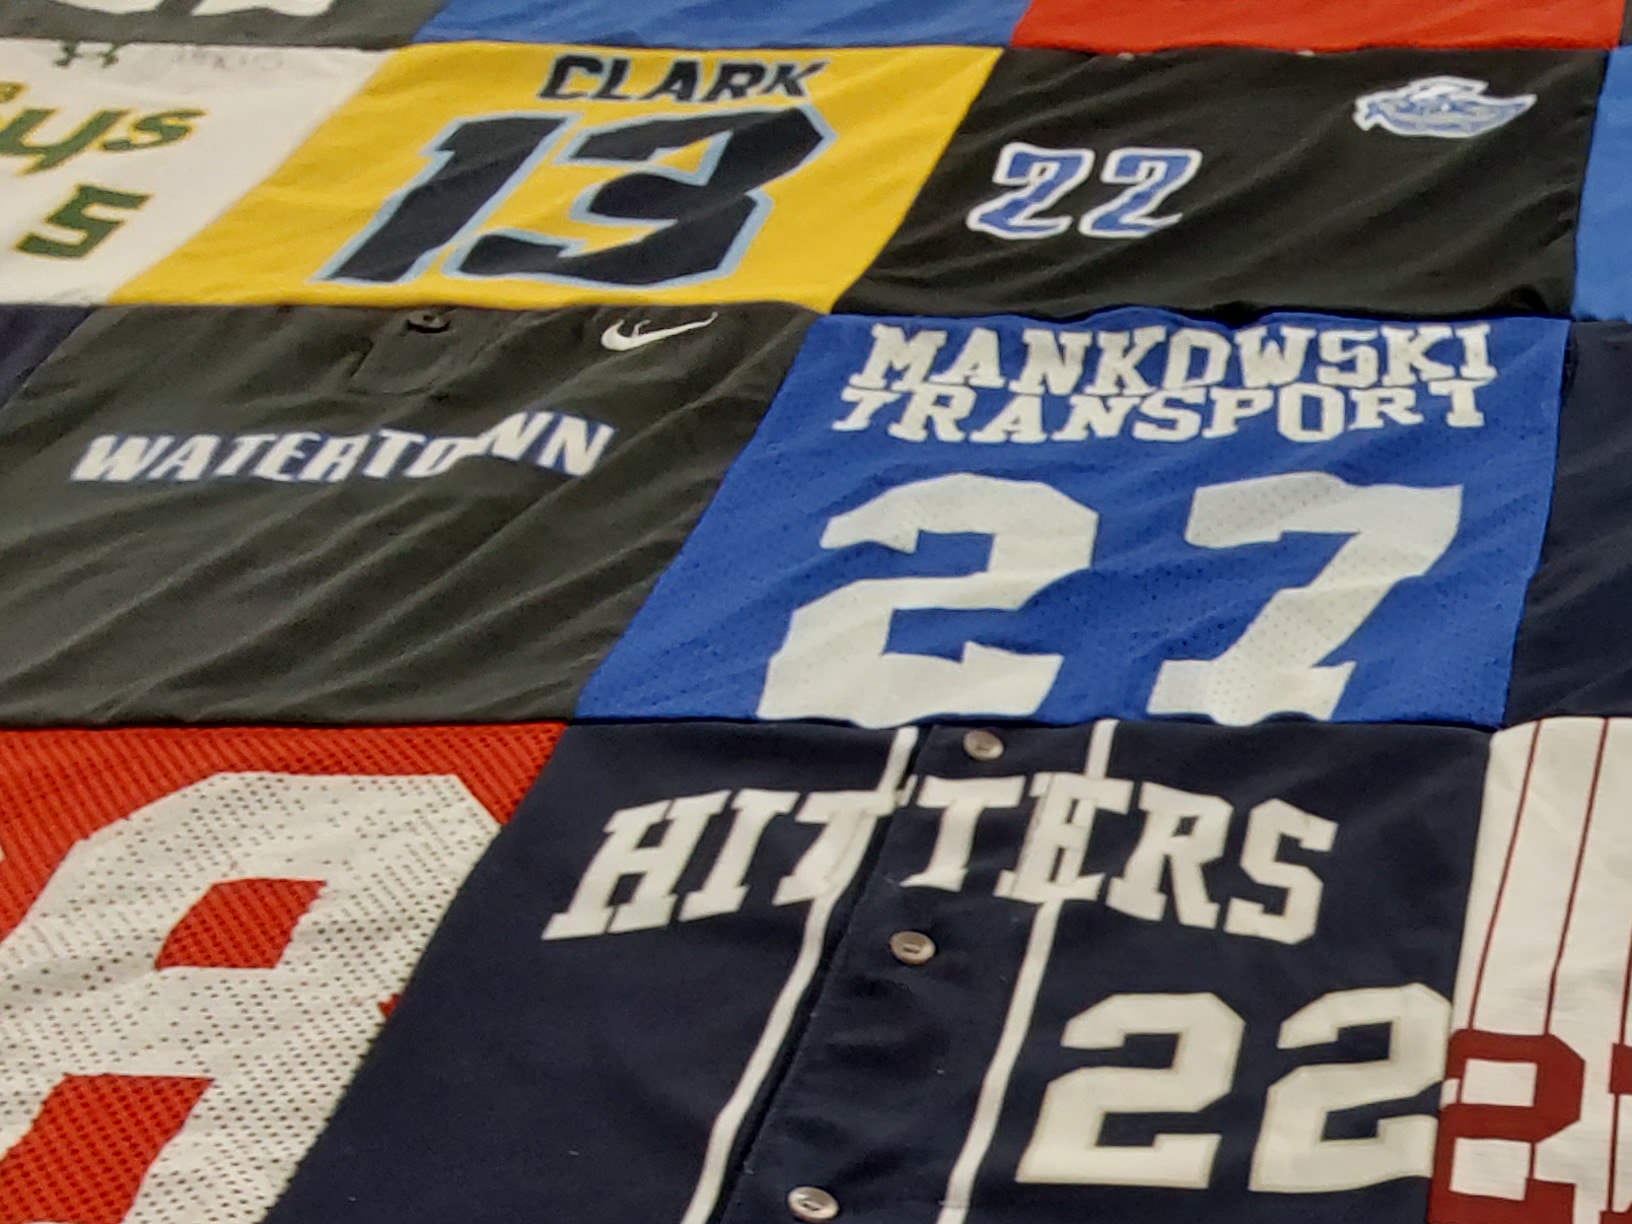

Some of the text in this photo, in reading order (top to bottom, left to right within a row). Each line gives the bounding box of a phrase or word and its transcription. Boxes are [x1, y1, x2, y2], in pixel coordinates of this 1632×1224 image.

[537, 55, 828, 103] CLARK
[14, 183, 155, 260] 5
[304, 103, 837, 289] 13
[966, 141, 1201, 240] 22
[848, 323, 1499, 396] MANKOWSKI
[70, 410, 619, 485] WATERTOWN
[833, 376, 1496, 443] TRANSPORT
[756, 471, 1463, 728] 27
[541, 771, 1338, 944] HITTERS
[1016, 983, 1453, 1193] 22
